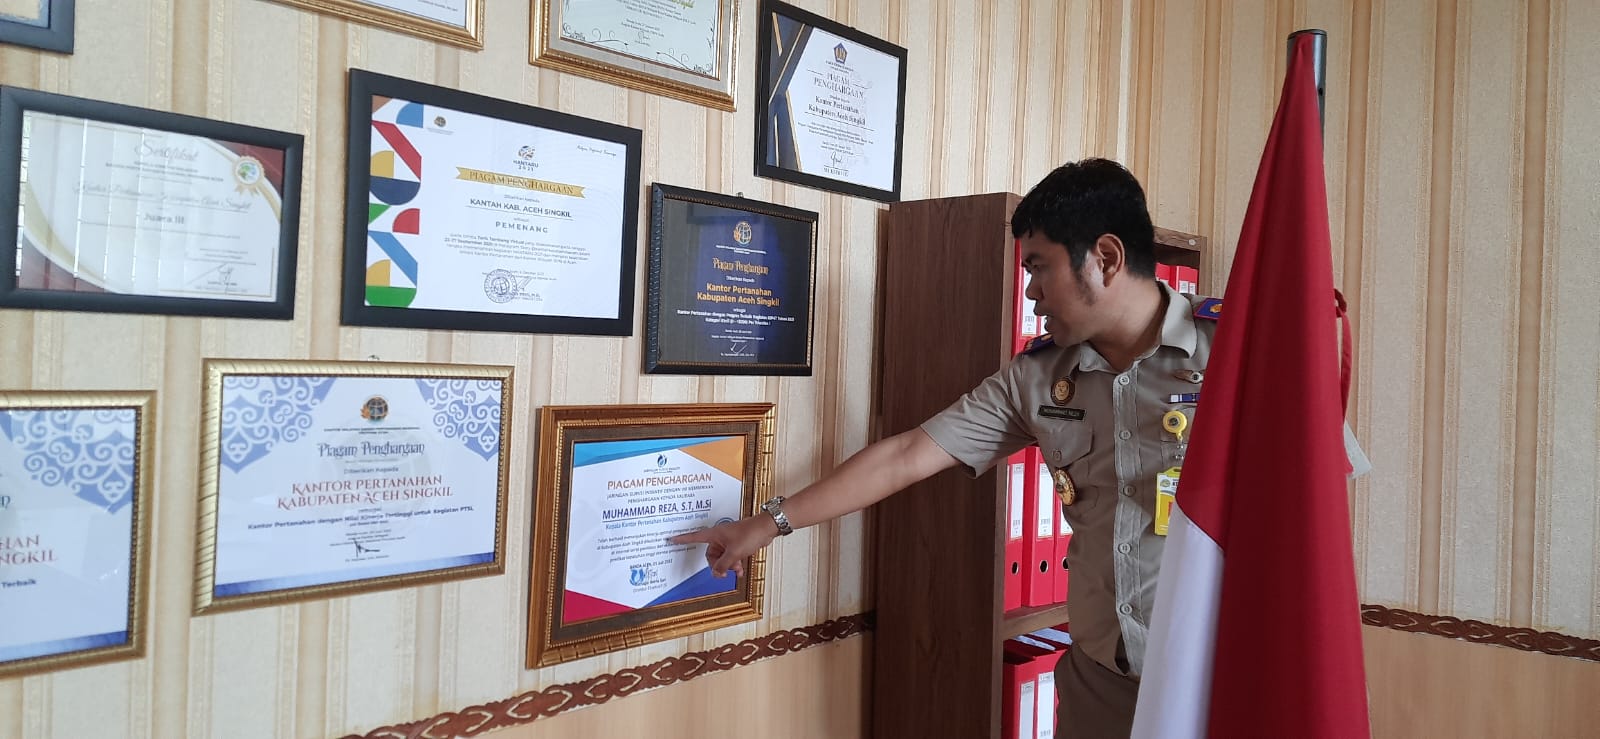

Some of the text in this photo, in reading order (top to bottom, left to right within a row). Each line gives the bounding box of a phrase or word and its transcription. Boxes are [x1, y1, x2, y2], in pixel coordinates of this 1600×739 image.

[814, 77, 865, 99] PENGHARGAAN
[815, 96, 832, 106] Kantor
[833, 99, 860, 115] Pertanahan
[808, 104, 866, 126] Kabupaten Aceh Singkil
[469, 171, 573, 194] PIAGAM PENGHARGAAN
[470, 198, 571, 218] KANTAH KAB. ACEH SINGKIL
[144, 214, 185, 225] Juara III
[495, 221, 549, 233] PEMENANG
[706, 283, 772, 297] Kantor Pertanahan
[697, 292, 780, 308] Kabupaten Aceh Singkil
[318, 440, 425, 458] Piagam Penghargaan
[292, 474, 442, 496] KANTOR PERTANAHAN
[607, 473, 712, 491] PIAGAM PENGHARGAAN
[277, 494, 361, 511] KABUPATEN
[362, 491, 400, 506] ACEH
[402, 486, 454, 500] SINGKIL
[602, 504, 656, 520] MUHAMMAD
[658, 502, 678, 514] REZA,
[695, 499, 712, 510] M.Si
[248, 523, 273, 531] Kantor
[274, 519, 316, 529] Pertanahan
[621, 519, 637, 528] Kantor
[638, 517, 662, 527] Pertanahan
